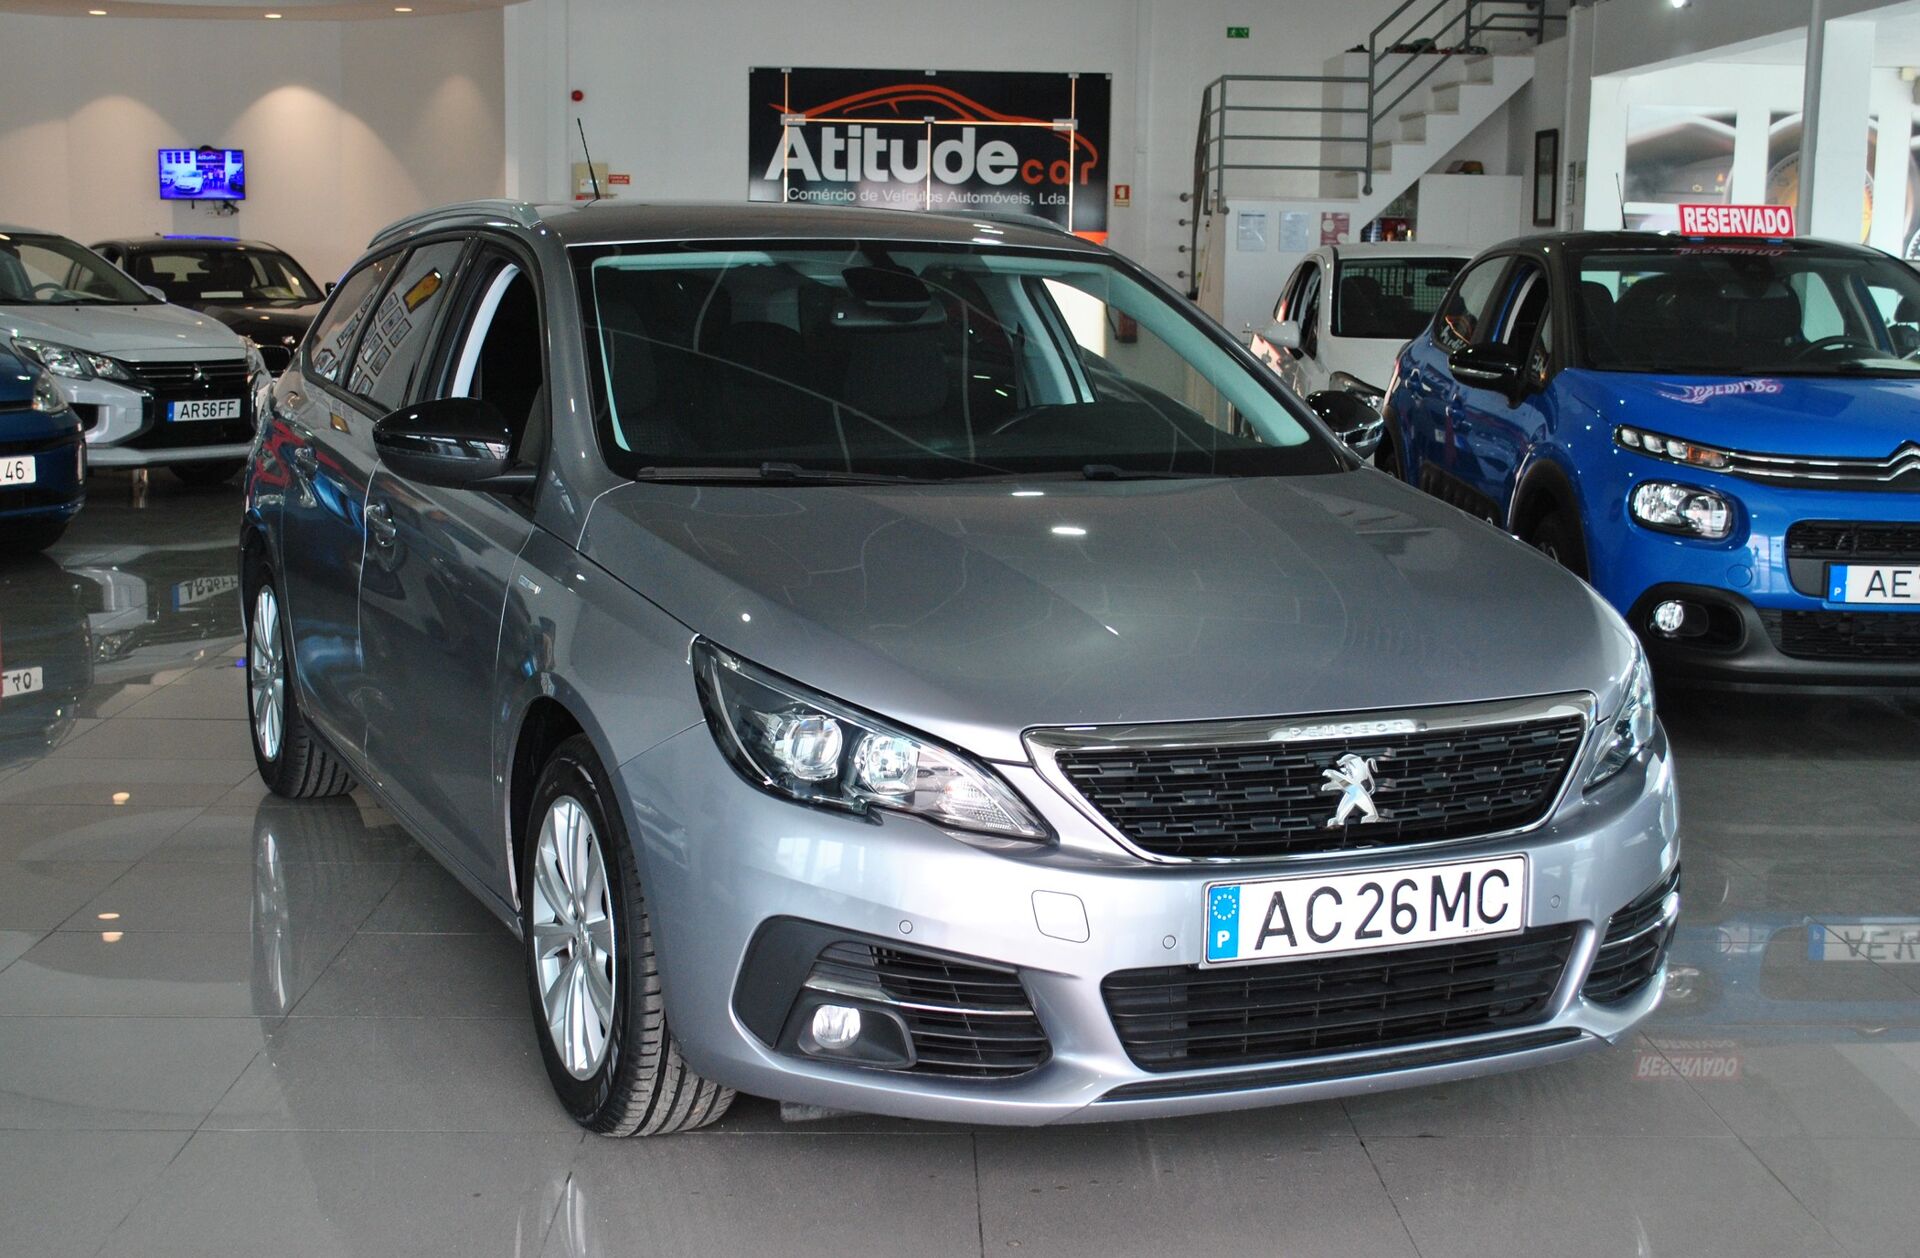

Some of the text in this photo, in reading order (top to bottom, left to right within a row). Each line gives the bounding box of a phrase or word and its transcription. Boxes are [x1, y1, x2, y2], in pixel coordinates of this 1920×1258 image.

[763, 124, 1018, 186] Atitude
[788, 187, 1071, 206] Comércio de Veículos Automóveis, Lda.
[1683, 207, 1790, 234] RESERVADO
[1289, 720, 1408, 738] PEUGEOT
[1217, 929, 1231, 949] P
